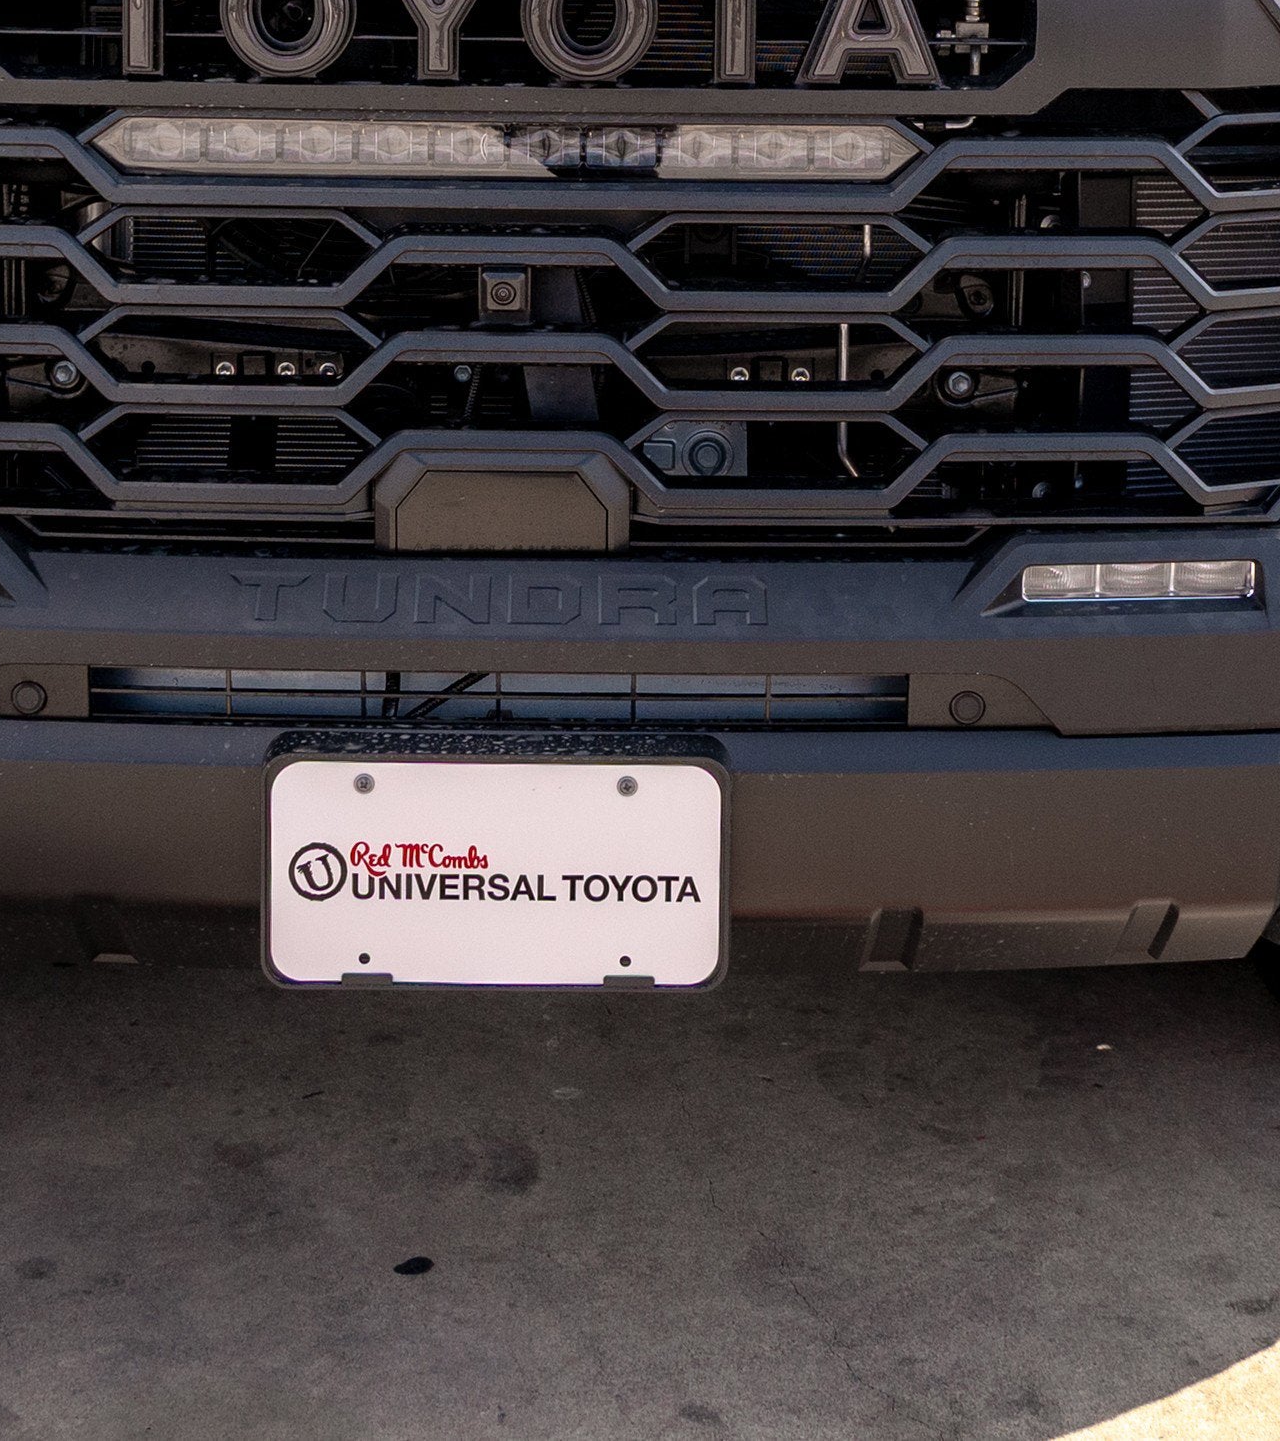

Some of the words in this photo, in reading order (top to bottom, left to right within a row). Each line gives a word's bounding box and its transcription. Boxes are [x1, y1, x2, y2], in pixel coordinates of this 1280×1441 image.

[230, 573, 768, 626] TUNDRA
[350, 841, 392, 877] Red
[395, 843, 489, 869] McCombs
[352, 873, 556, 902] UNIVERSAL
[562, 875, 702, 903] TOYOTA
